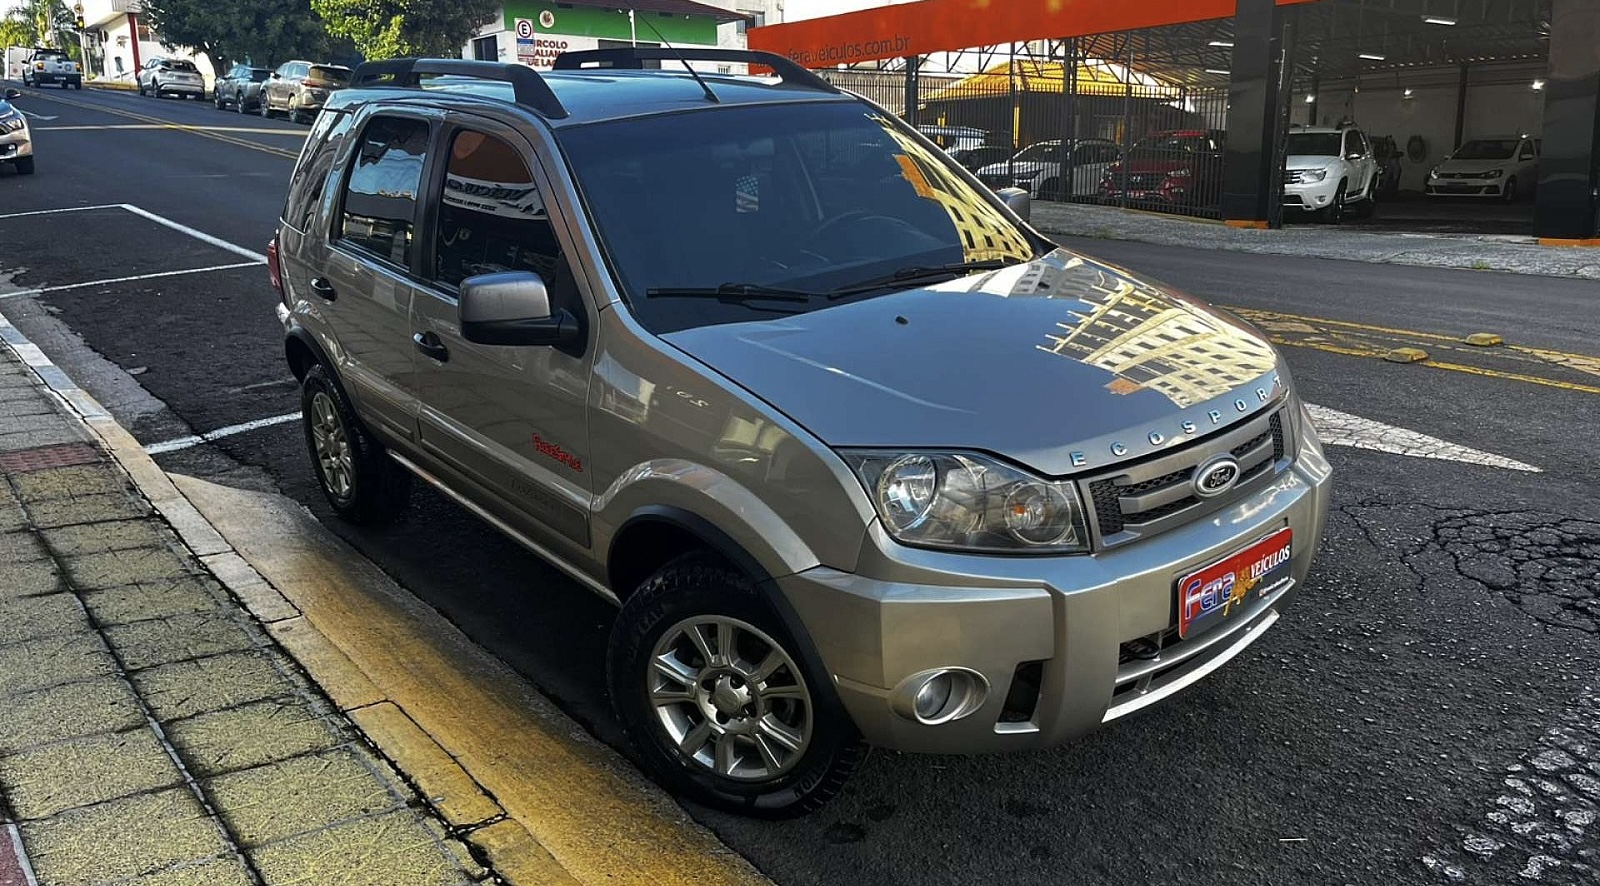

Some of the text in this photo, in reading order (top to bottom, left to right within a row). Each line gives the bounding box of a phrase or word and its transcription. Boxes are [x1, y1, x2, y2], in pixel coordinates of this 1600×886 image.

[521, 25, 528, 34] E
[535, 49, 565, 57] ALIAN
[1070, 375, 1283, 467] ECOSPORT
[1209, 468, 1231, 488] Ford
[1184, 571, 1236, 621] Fera
[1249, 544, 1291, 578] VEÍCULOS
